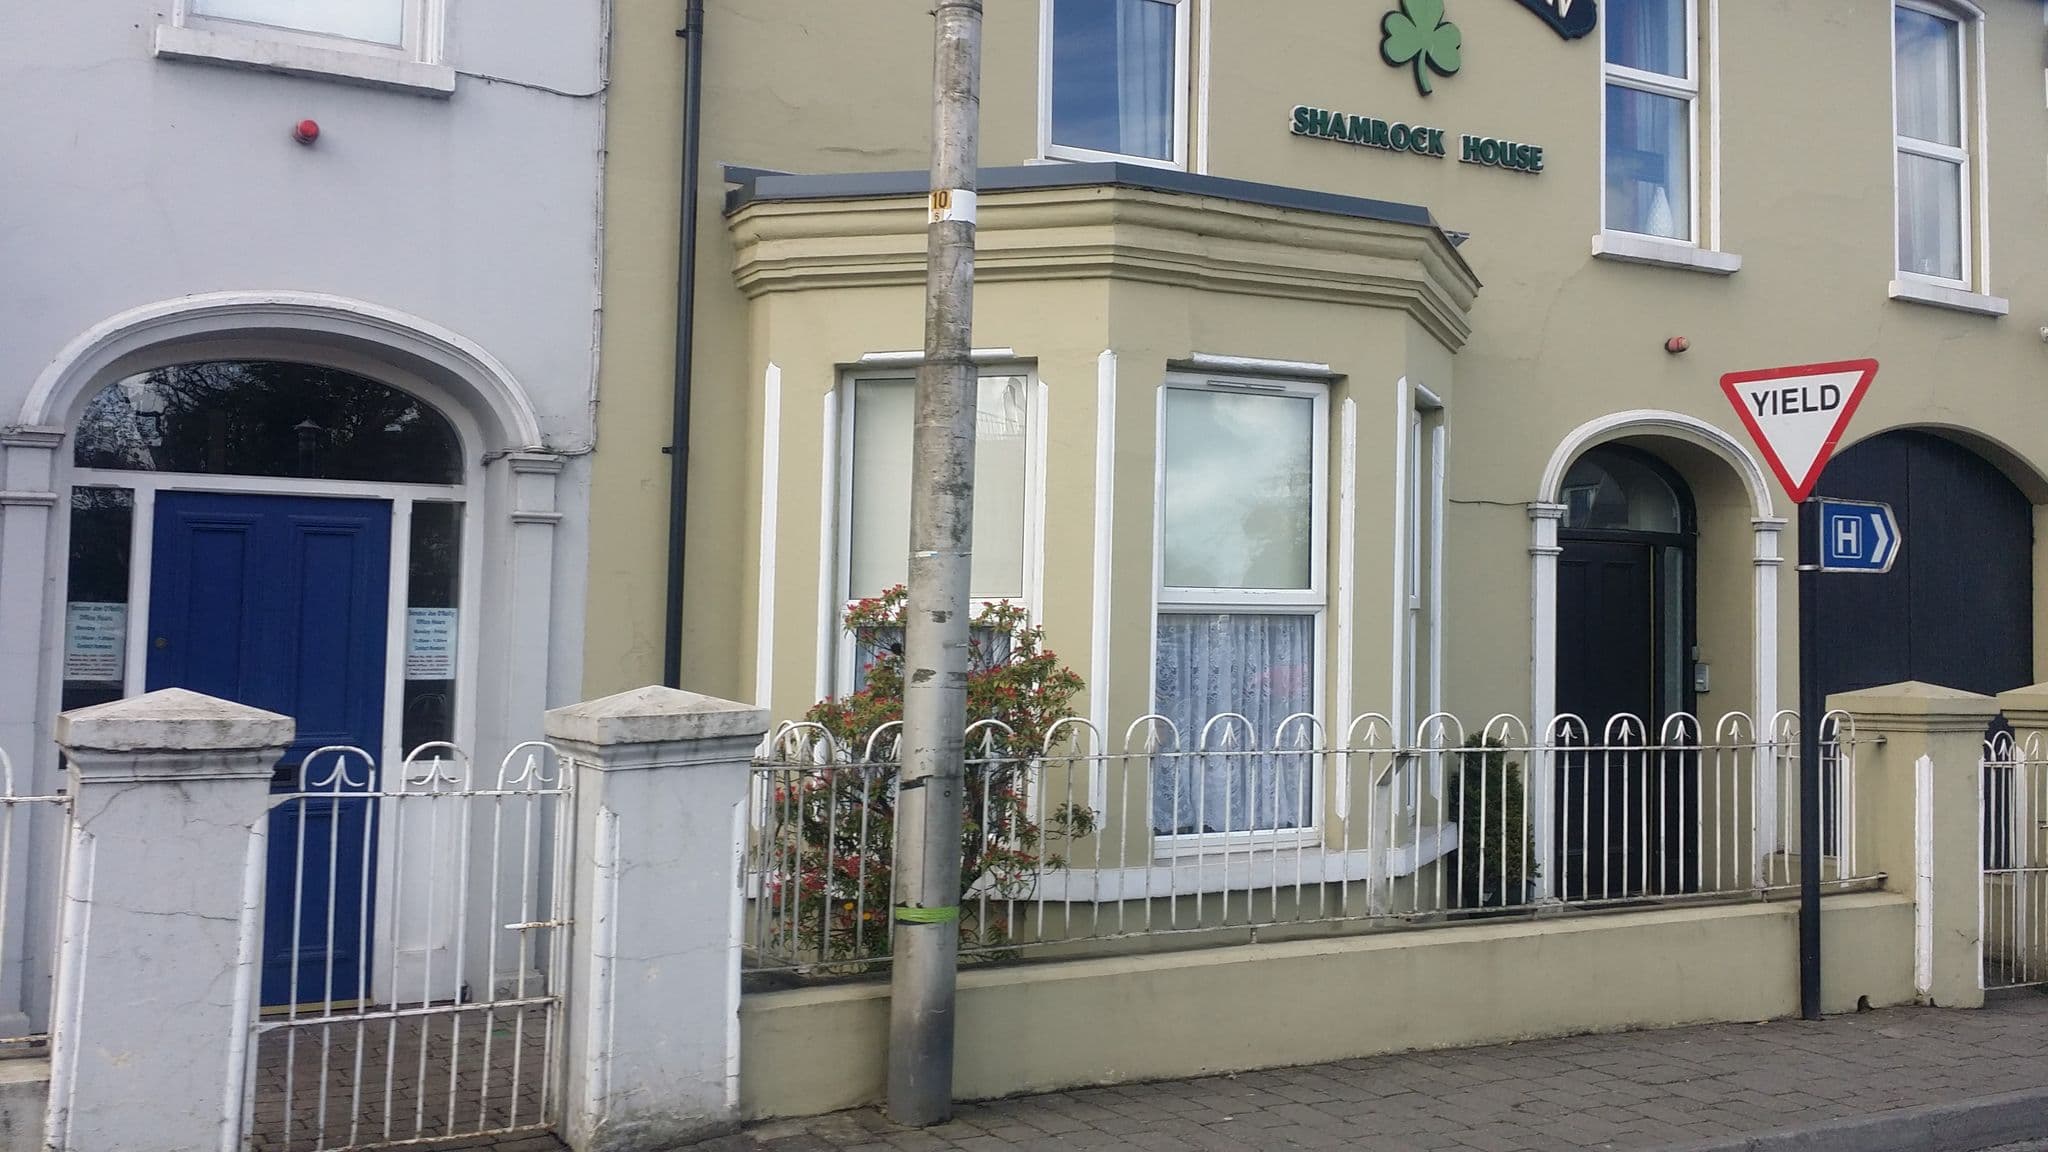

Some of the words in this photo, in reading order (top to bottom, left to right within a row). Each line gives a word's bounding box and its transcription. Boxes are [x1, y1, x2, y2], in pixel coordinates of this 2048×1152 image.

[1290, 105, 1446, 158] SHAMROCK
[1458, 134, 1544, 174] HOUSE
[932, 190, 948, 209] 10
[1751, 384, 1841, 417] YIELD
[1837, 519, 1858, 554] H
